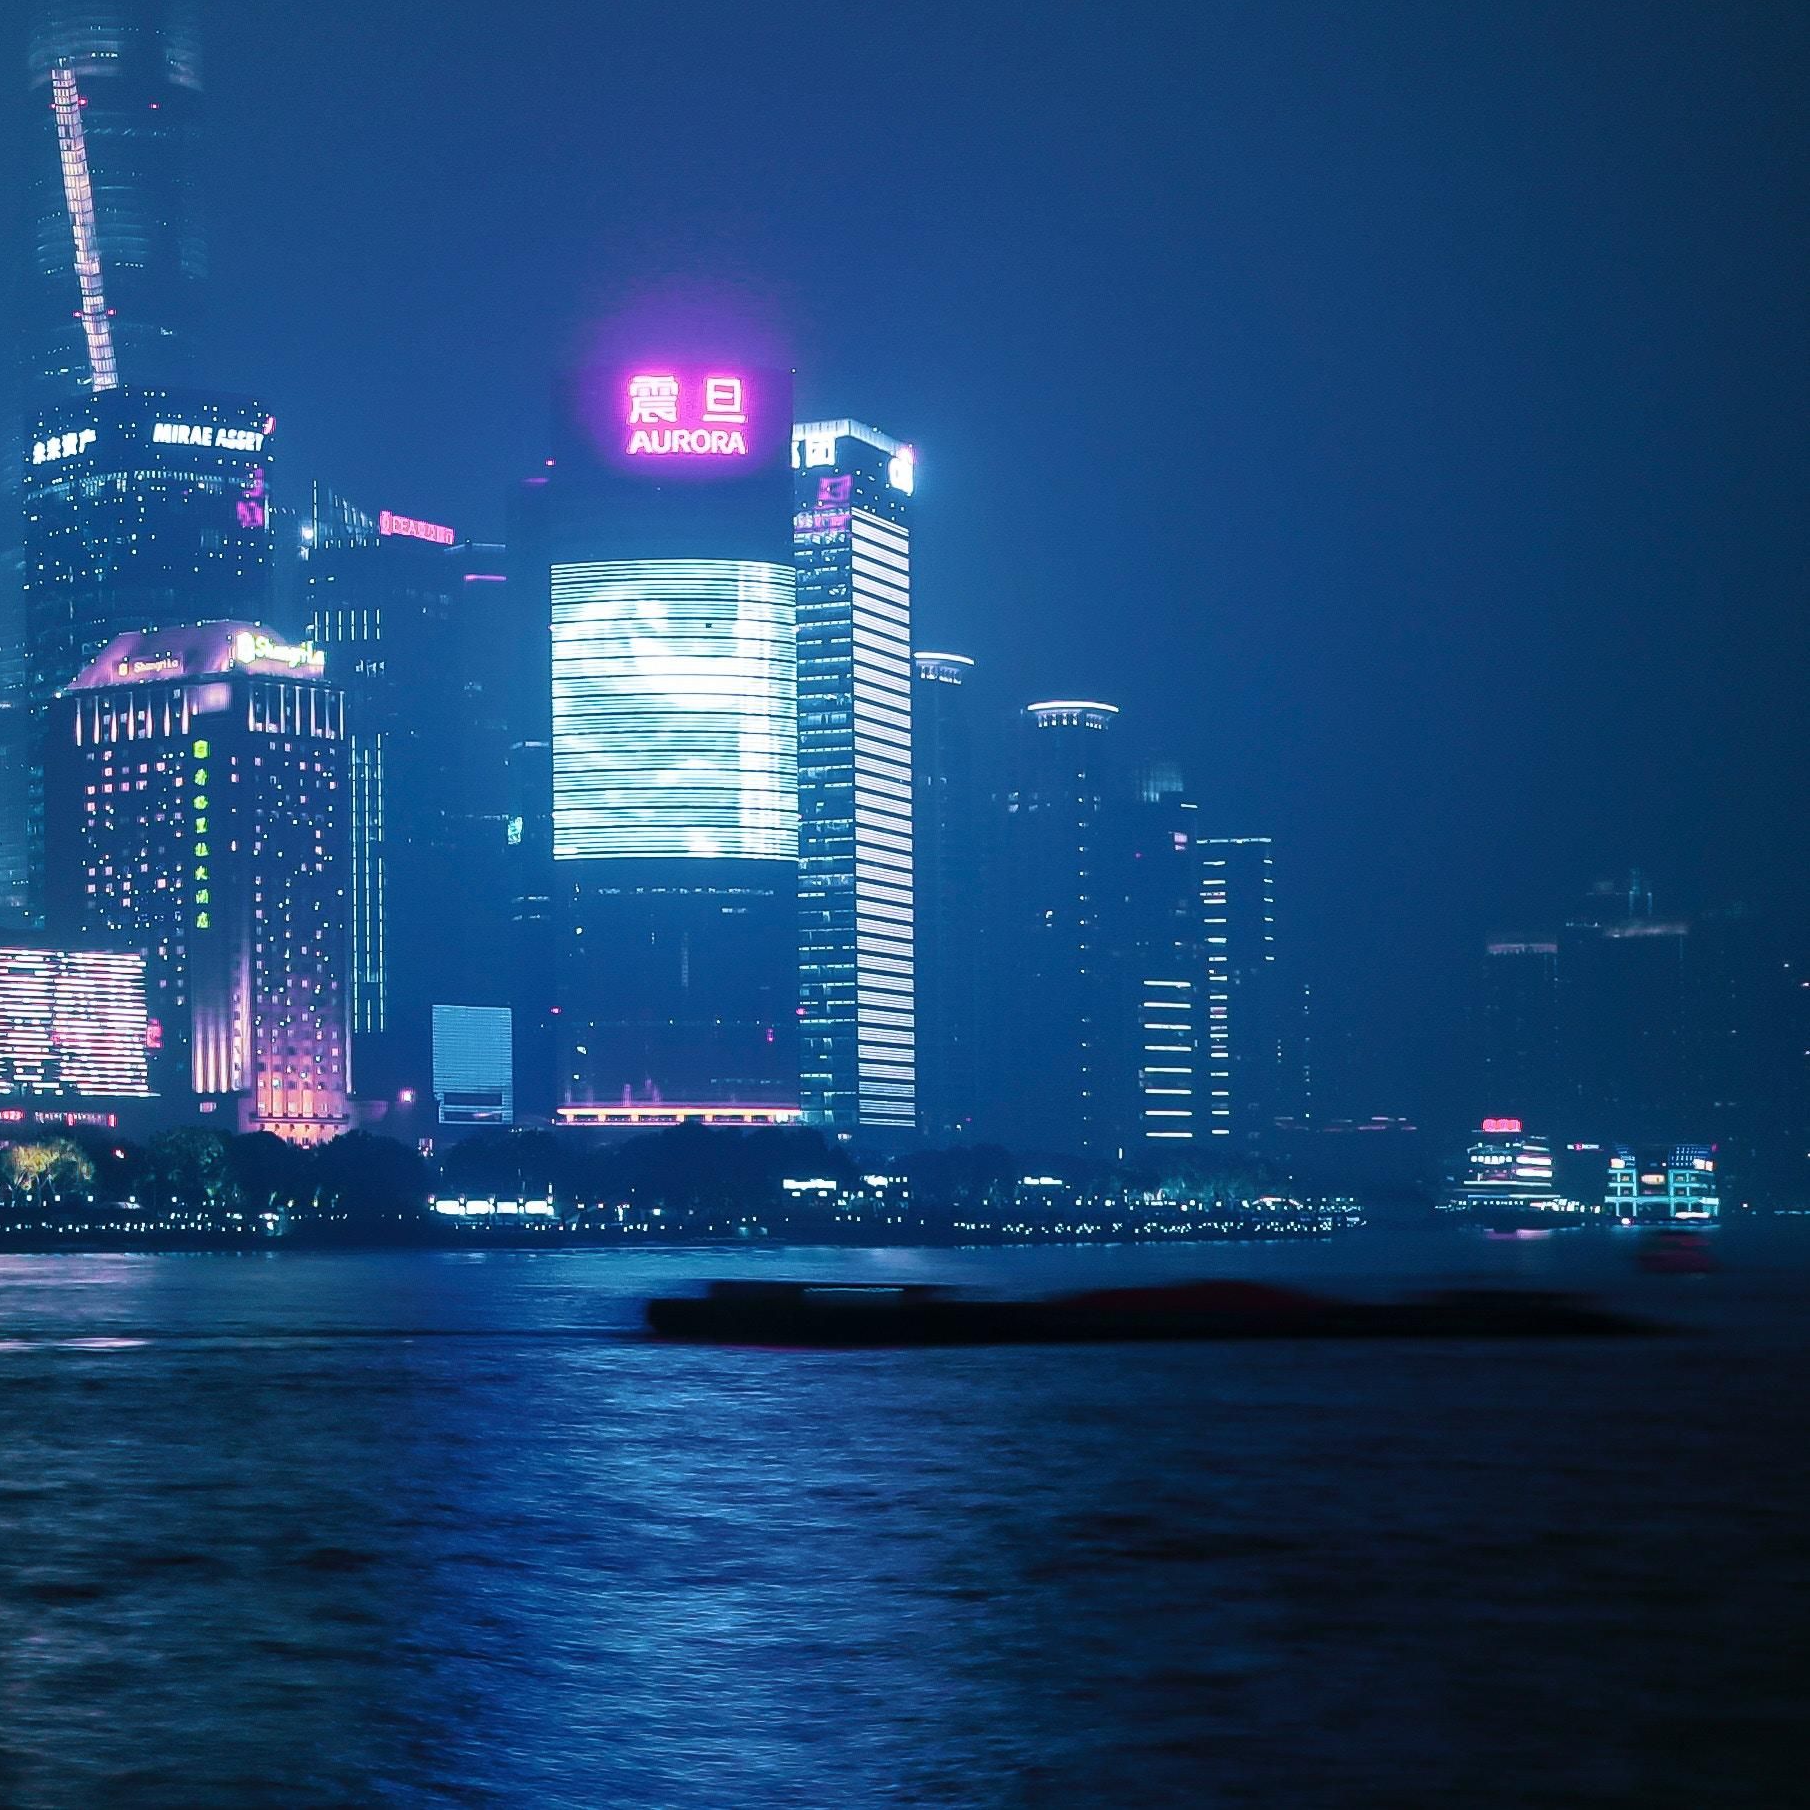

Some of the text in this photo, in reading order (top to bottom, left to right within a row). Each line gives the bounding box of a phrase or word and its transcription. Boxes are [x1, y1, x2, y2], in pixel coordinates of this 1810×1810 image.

[628, 375, 748, 424] 震旦
[152, 422, 265, 452] MIRAE ASSET
[626, 428, 747, 455] AURORA
